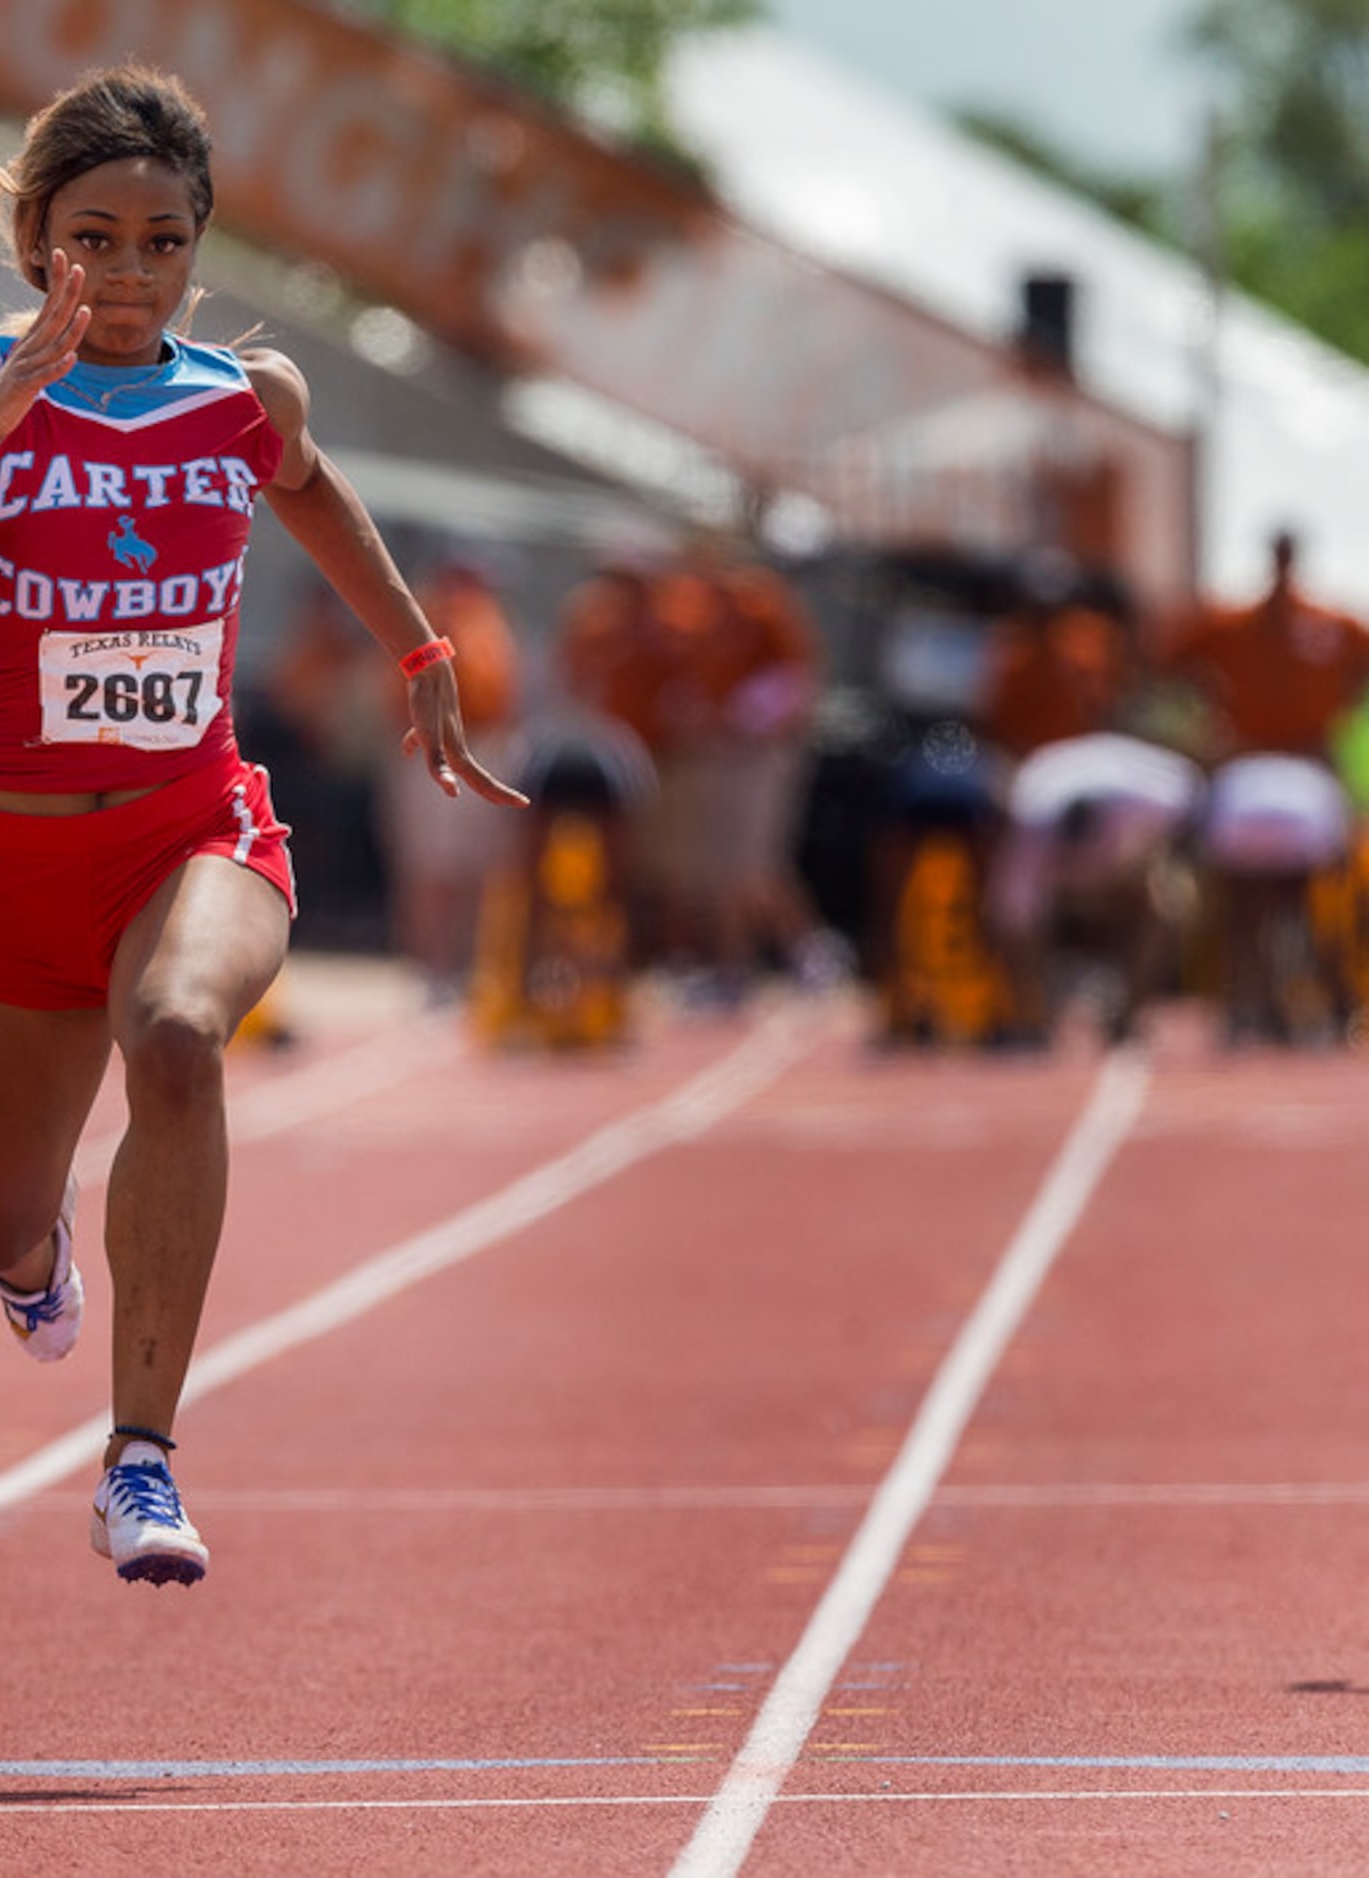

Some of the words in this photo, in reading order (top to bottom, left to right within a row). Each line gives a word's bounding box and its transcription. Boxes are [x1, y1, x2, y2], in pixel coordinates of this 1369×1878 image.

[70, 633, 132, 658] TEXAS
[138, 631, 201, 656] RELAYS
[65, 671, 204, 725] 2687
